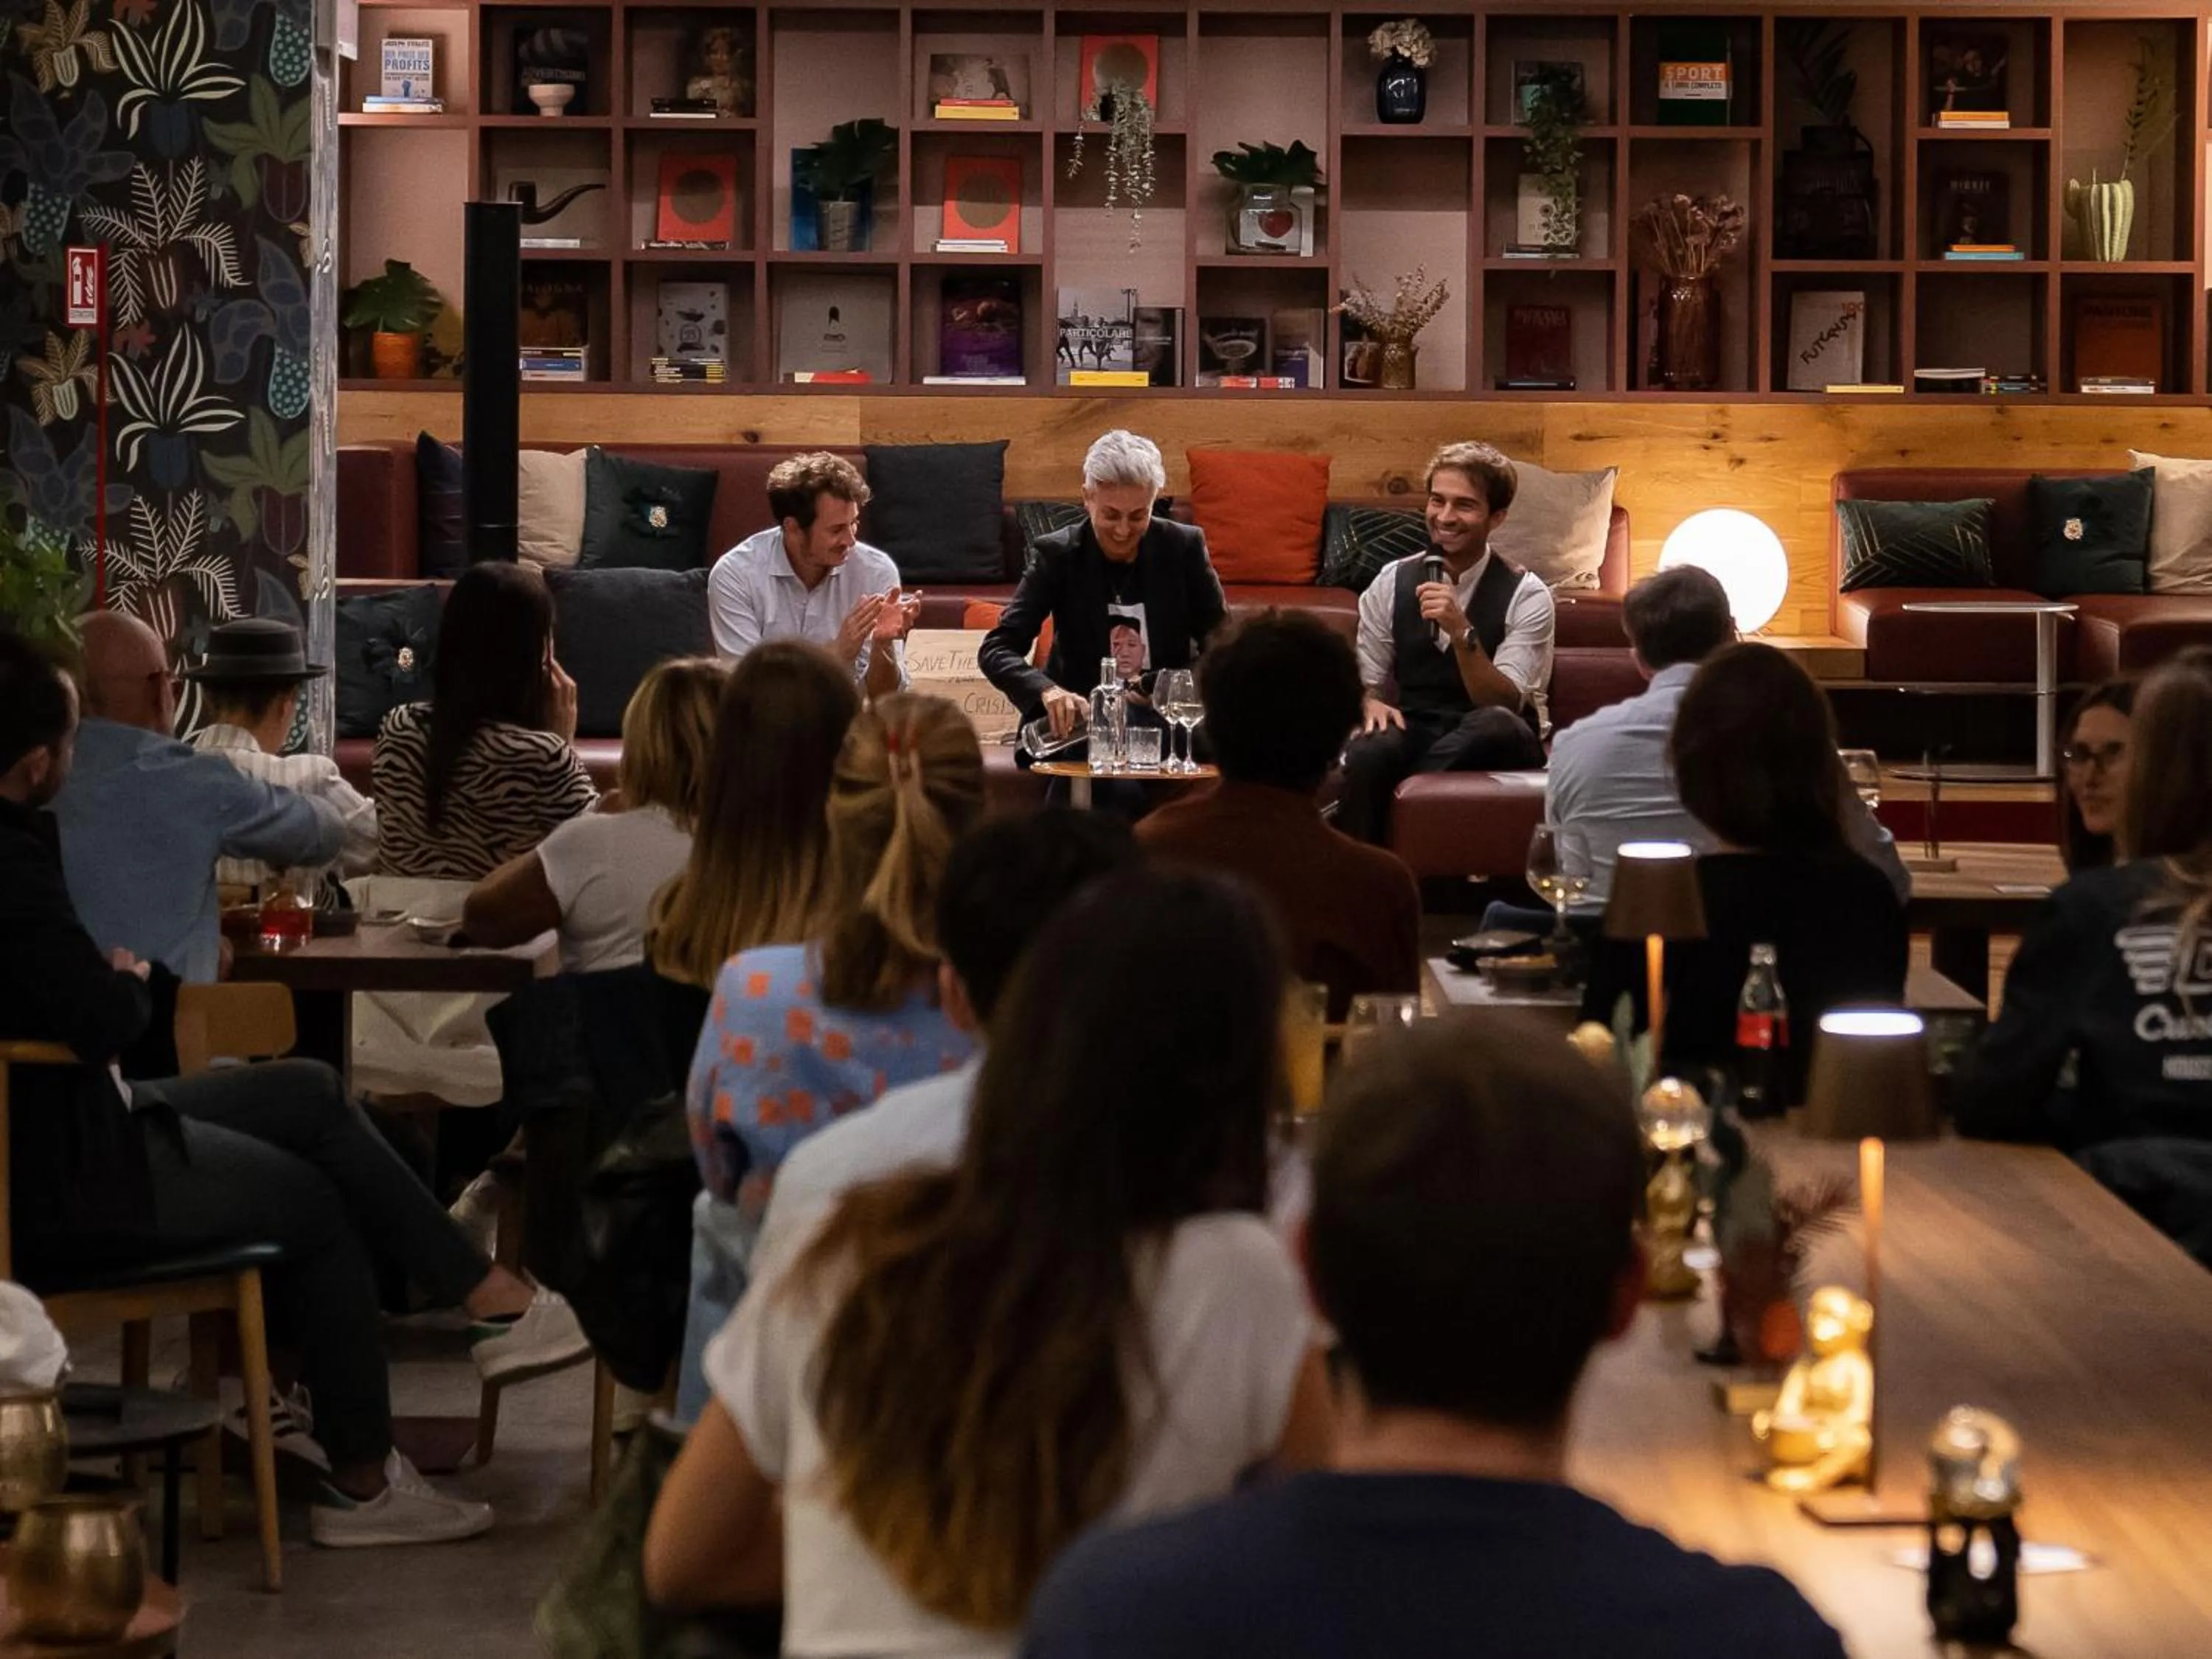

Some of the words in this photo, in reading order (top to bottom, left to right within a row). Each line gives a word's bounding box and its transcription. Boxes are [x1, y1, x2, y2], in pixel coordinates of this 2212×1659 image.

[384, 59, 430, 71] PROFITS
[1664, 66, 1723, 81] SPORT
[964, 692, 1016, 714] CRISIS
